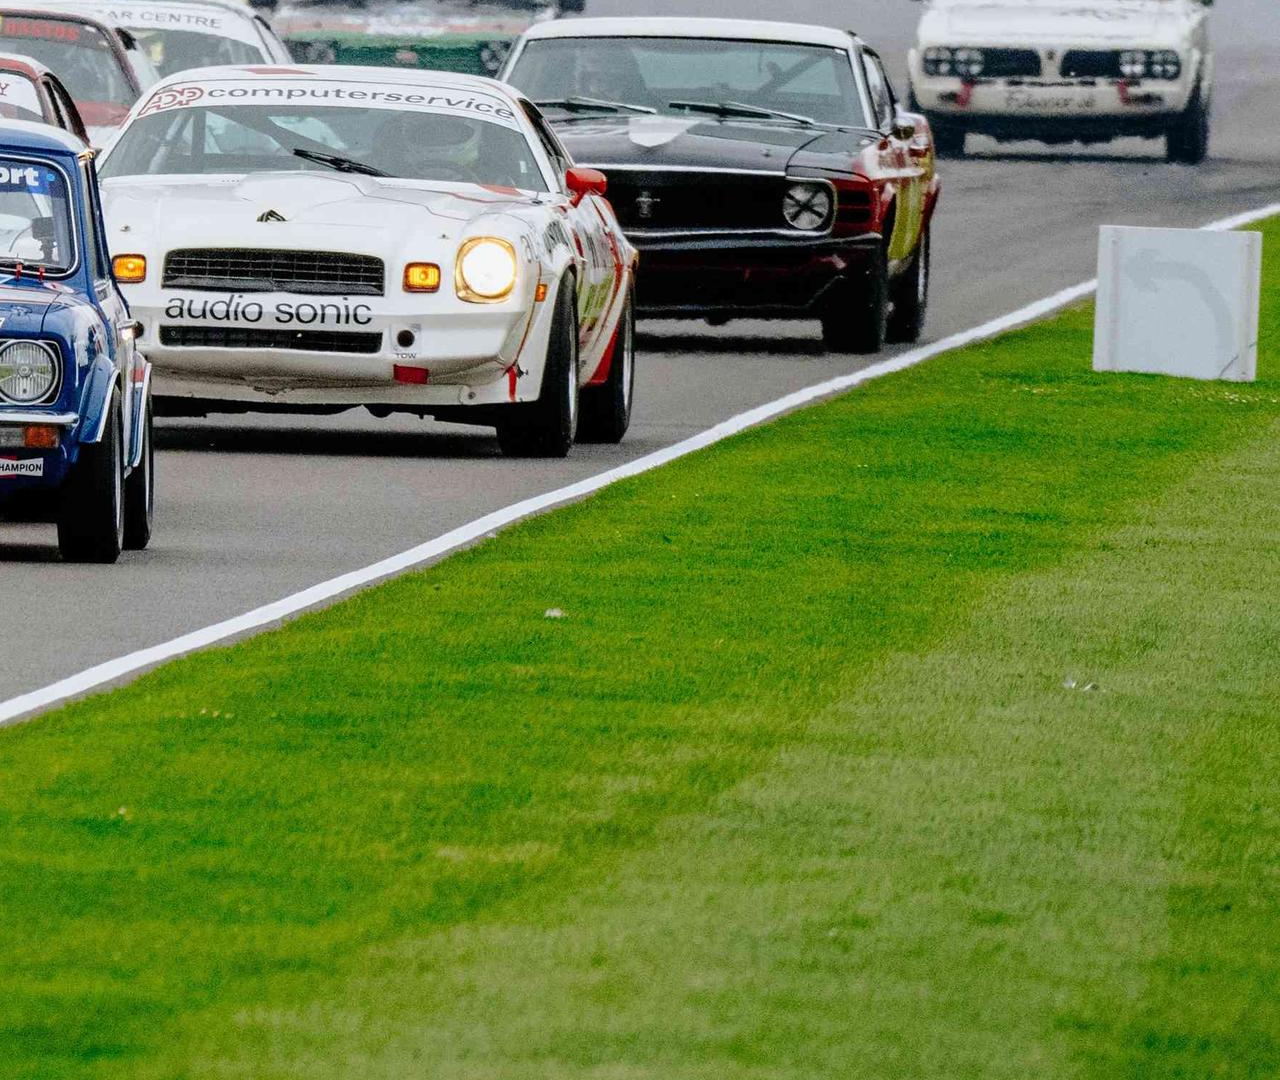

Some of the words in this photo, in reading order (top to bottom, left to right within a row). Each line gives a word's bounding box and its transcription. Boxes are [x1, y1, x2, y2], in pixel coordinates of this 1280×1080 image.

[141, 13, 223, 29] CENTRE
[208, 87, 514, 120] computerservice
[165, 295, 263, 323] audio
[274, 297, 373, 324] sonic
